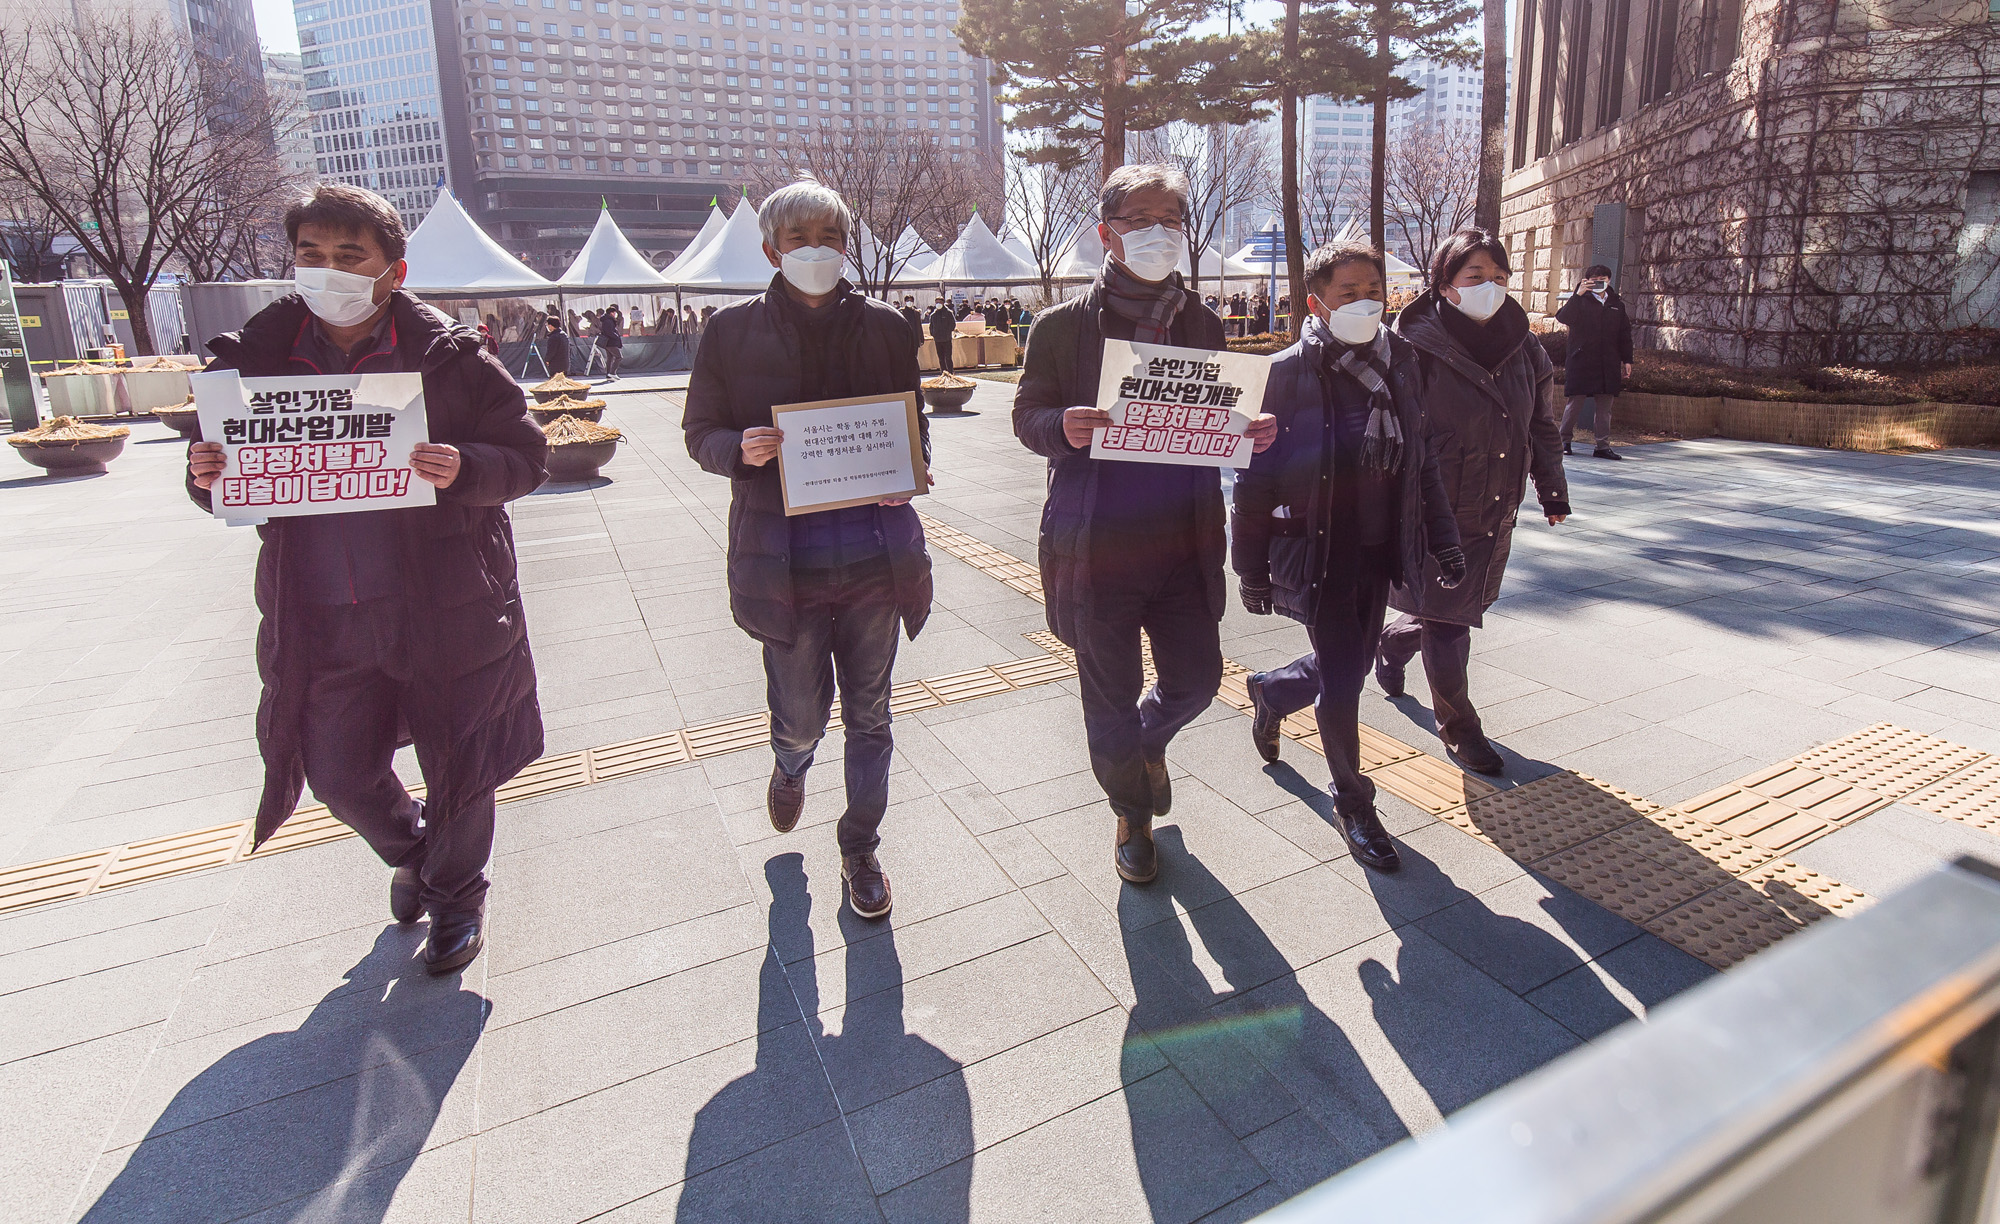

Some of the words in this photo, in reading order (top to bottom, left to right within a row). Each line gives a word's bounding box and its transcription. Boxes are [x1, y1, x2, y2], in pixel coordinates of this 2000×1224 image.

[1148, 357, 1221, 382] 살인기업
[249, 388, 353, 415] 살인기업
[1119, 376, 1243, 407] 현대산업개발
[222, 413, 396, 445] 현대산업개발
[803, 425, 833, 434] 서울시는
[836, 422, 851, 431] 학동
[854, 419, 868, 429] 참사
[1124, 402, 1229, 432] 엄정처벌과
[800, 449, 823, 460] 강력한
[827, 444, 863, 456] 행정처분을
[865, 440, 895, 452] 실시하라!
[804, 434, 855, 446] 현대산업개발에
[859, 431, 872, 440] 대해
[875, 429, 889, 438] 가장
[1102, 425, 1170, 453] 퇴출이
[1167, 430, 1241, 458] 답이다!
[238, 440, 387, 477] 엄정처벌과
[222, 473, 306, 507] 퇴출이
[307, 468, 412, 503] 답이다!
